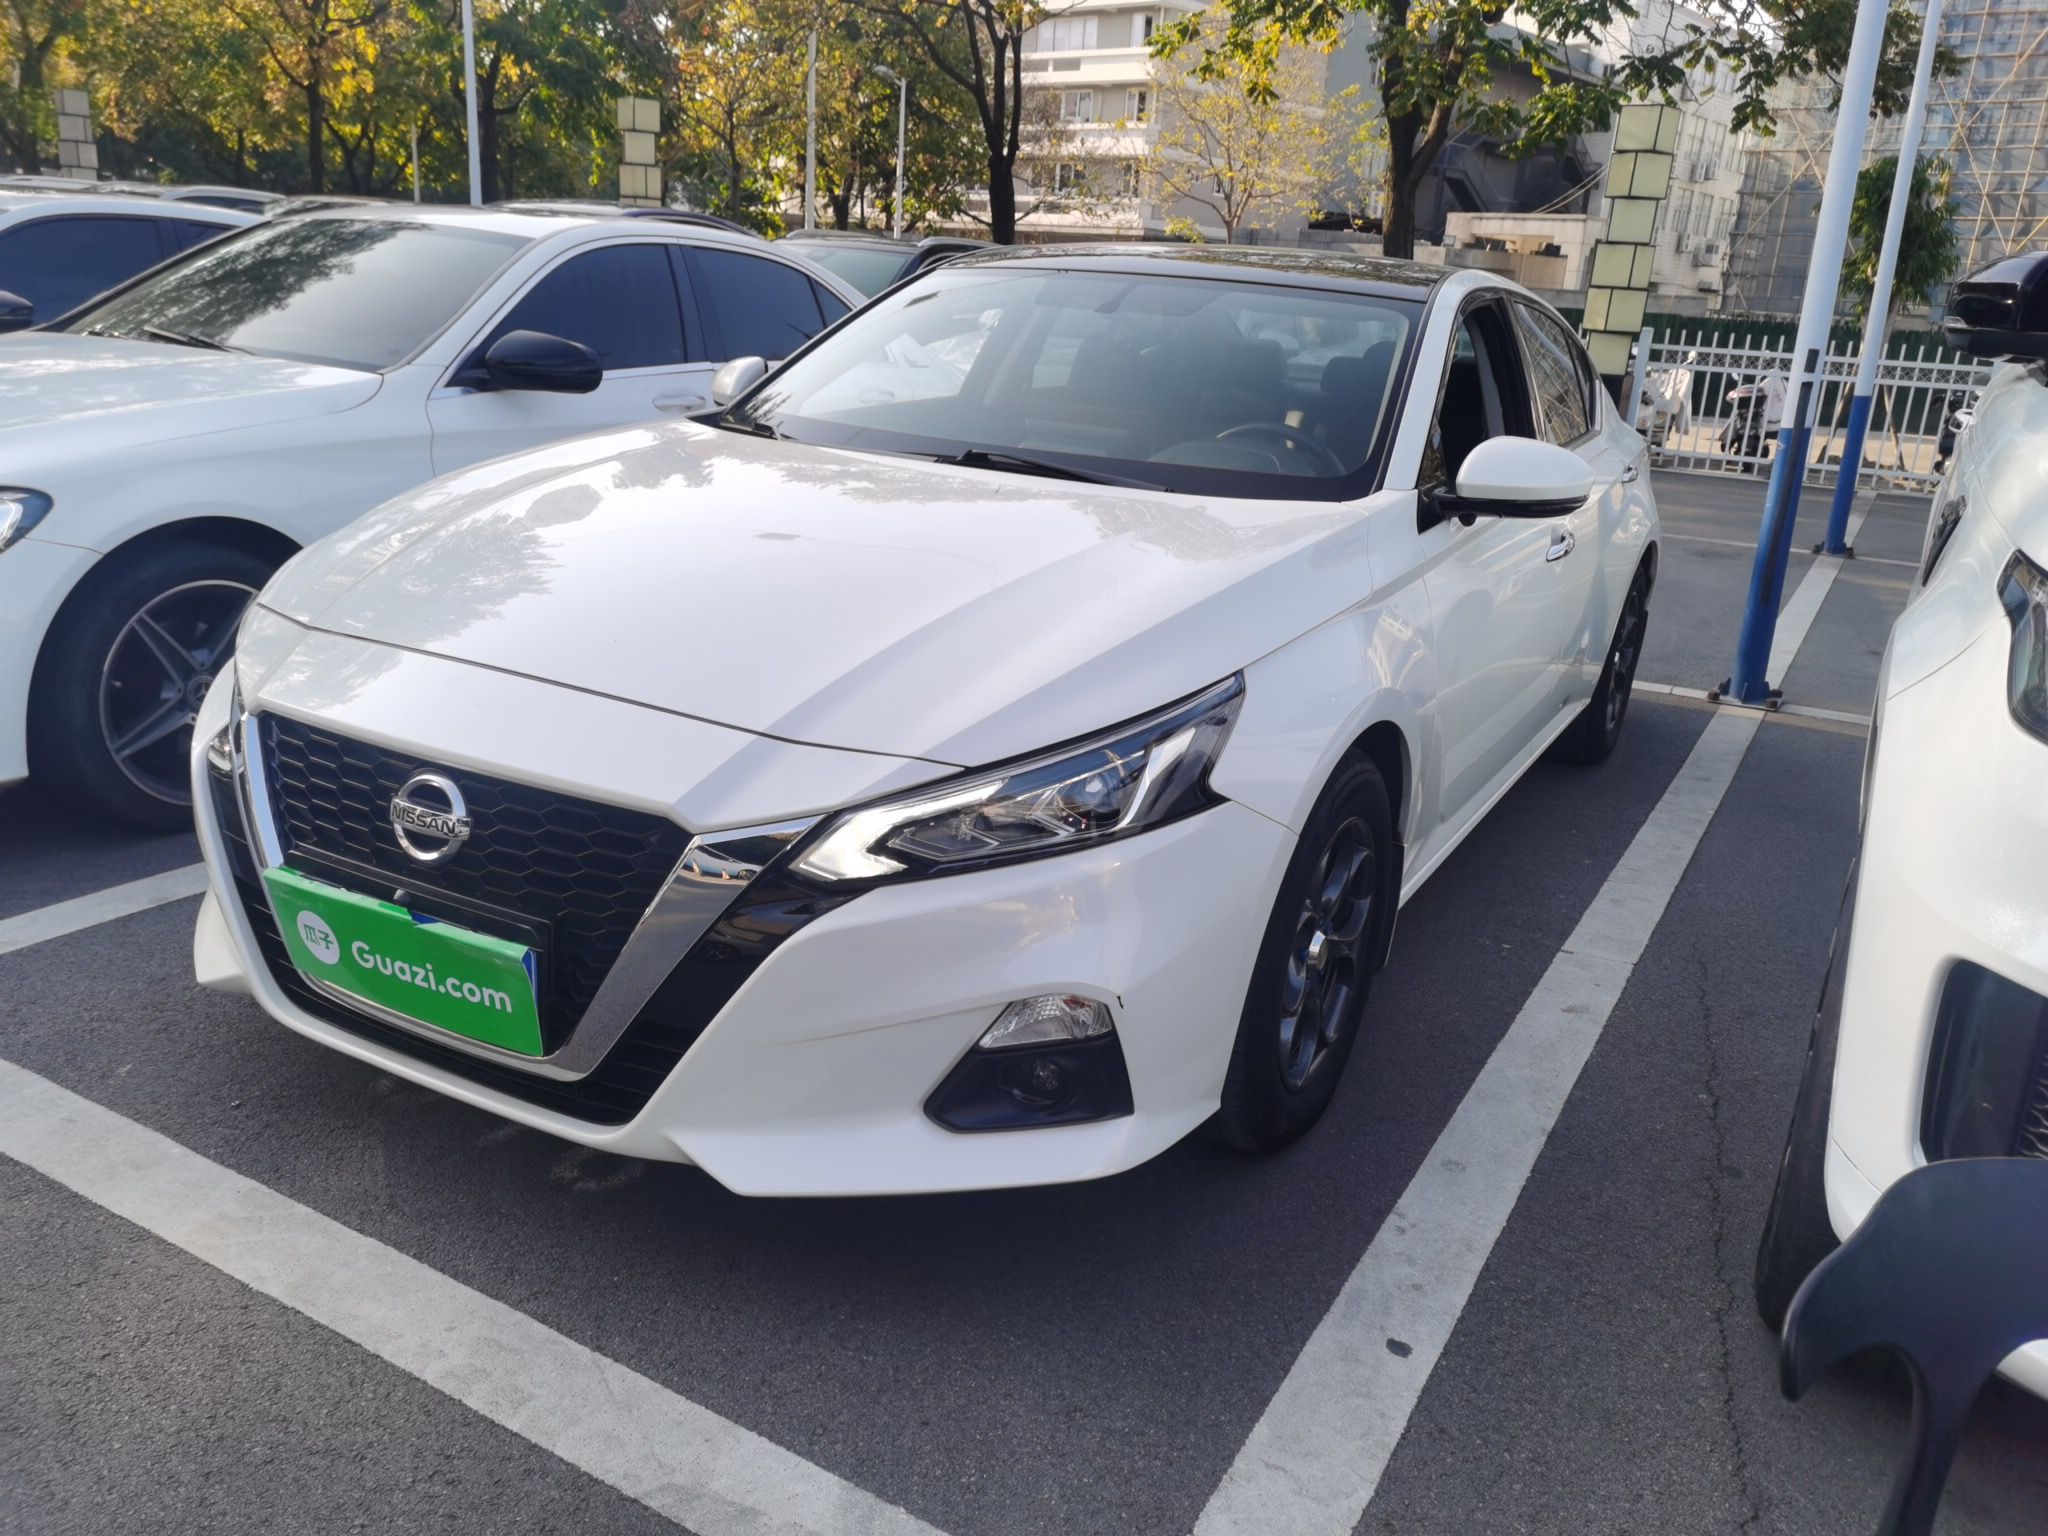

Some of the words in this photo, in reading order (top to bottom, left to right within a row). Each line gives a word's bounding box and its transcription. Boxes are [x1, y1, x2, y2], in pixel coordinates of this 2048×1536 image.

[390, 804, 457, 836] NISSAN
[302, 922, 335, 951] 瓜子
[350, 940, 513, 1014] Guazi.com
